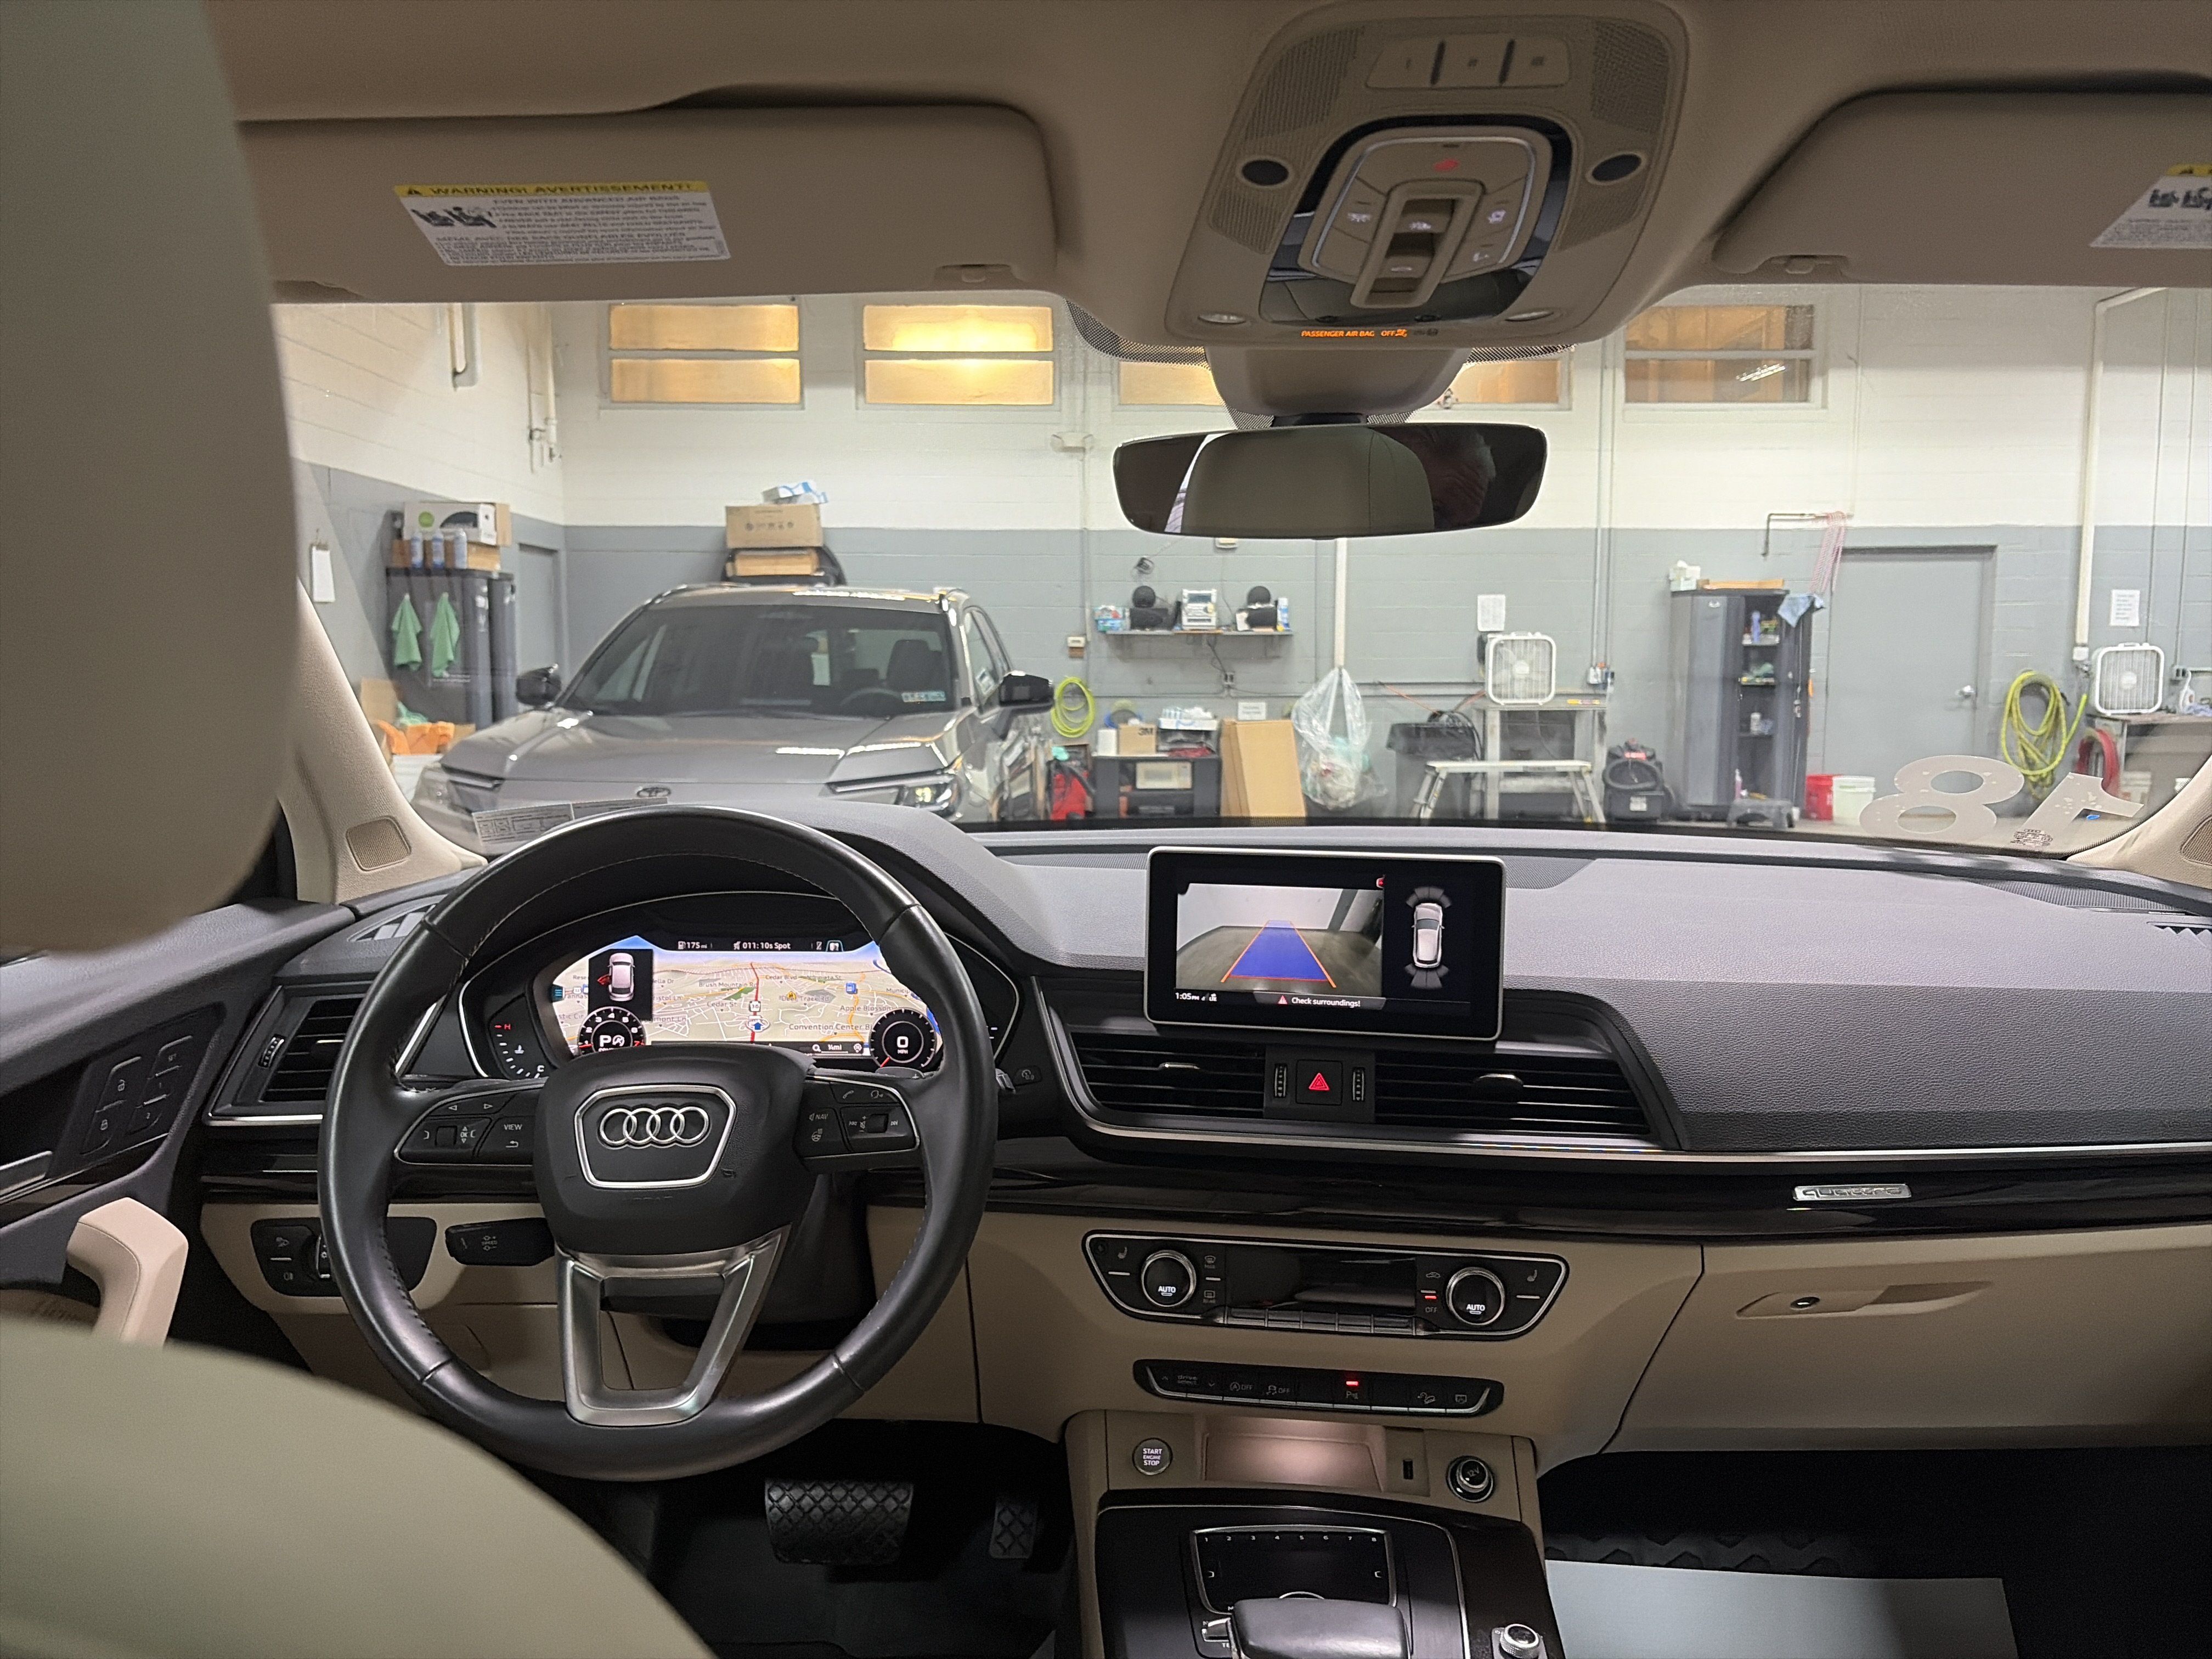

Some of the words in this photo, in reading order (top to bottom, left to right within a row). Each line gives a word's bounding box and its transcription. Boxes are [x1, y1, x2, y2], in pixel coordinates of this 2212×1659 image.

[1138, 727, 1154, 736] 3M
[774, 941, 791, 951] Spot
[1312, 998, 1361, 1008] surroundings!
[600, 1035, 612, 1047] P
[896, 1036, 909, 1048] 0
